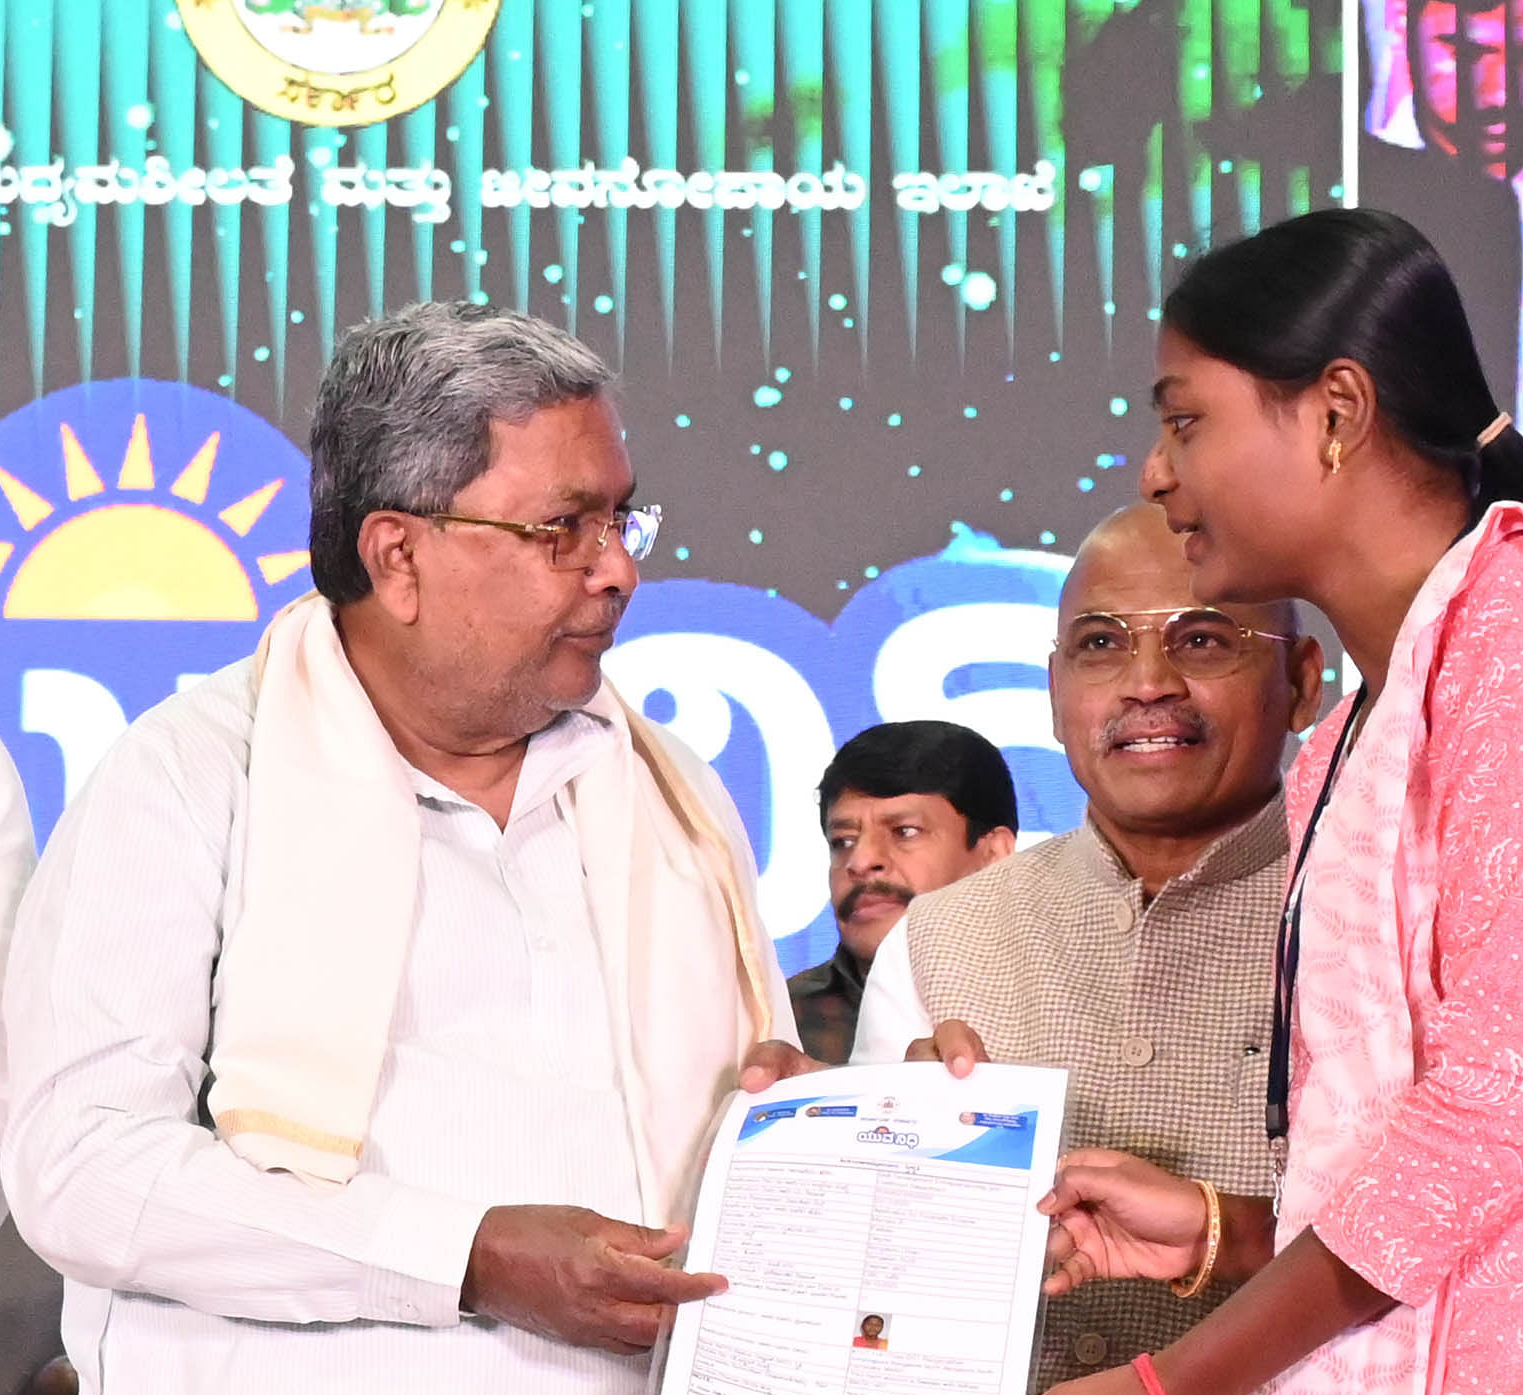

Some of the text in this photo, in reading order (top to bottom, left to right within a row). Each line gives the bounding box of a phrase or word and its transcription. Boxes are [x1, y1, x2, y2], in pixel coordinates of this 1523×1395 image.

[322, 158, 452, 224] ಮತ್ತು
[482, 156, 866, 212] ಜೀವನೋಪಾಯ
[893, 156, 1056, 213] ಇಲಾಖೆ
